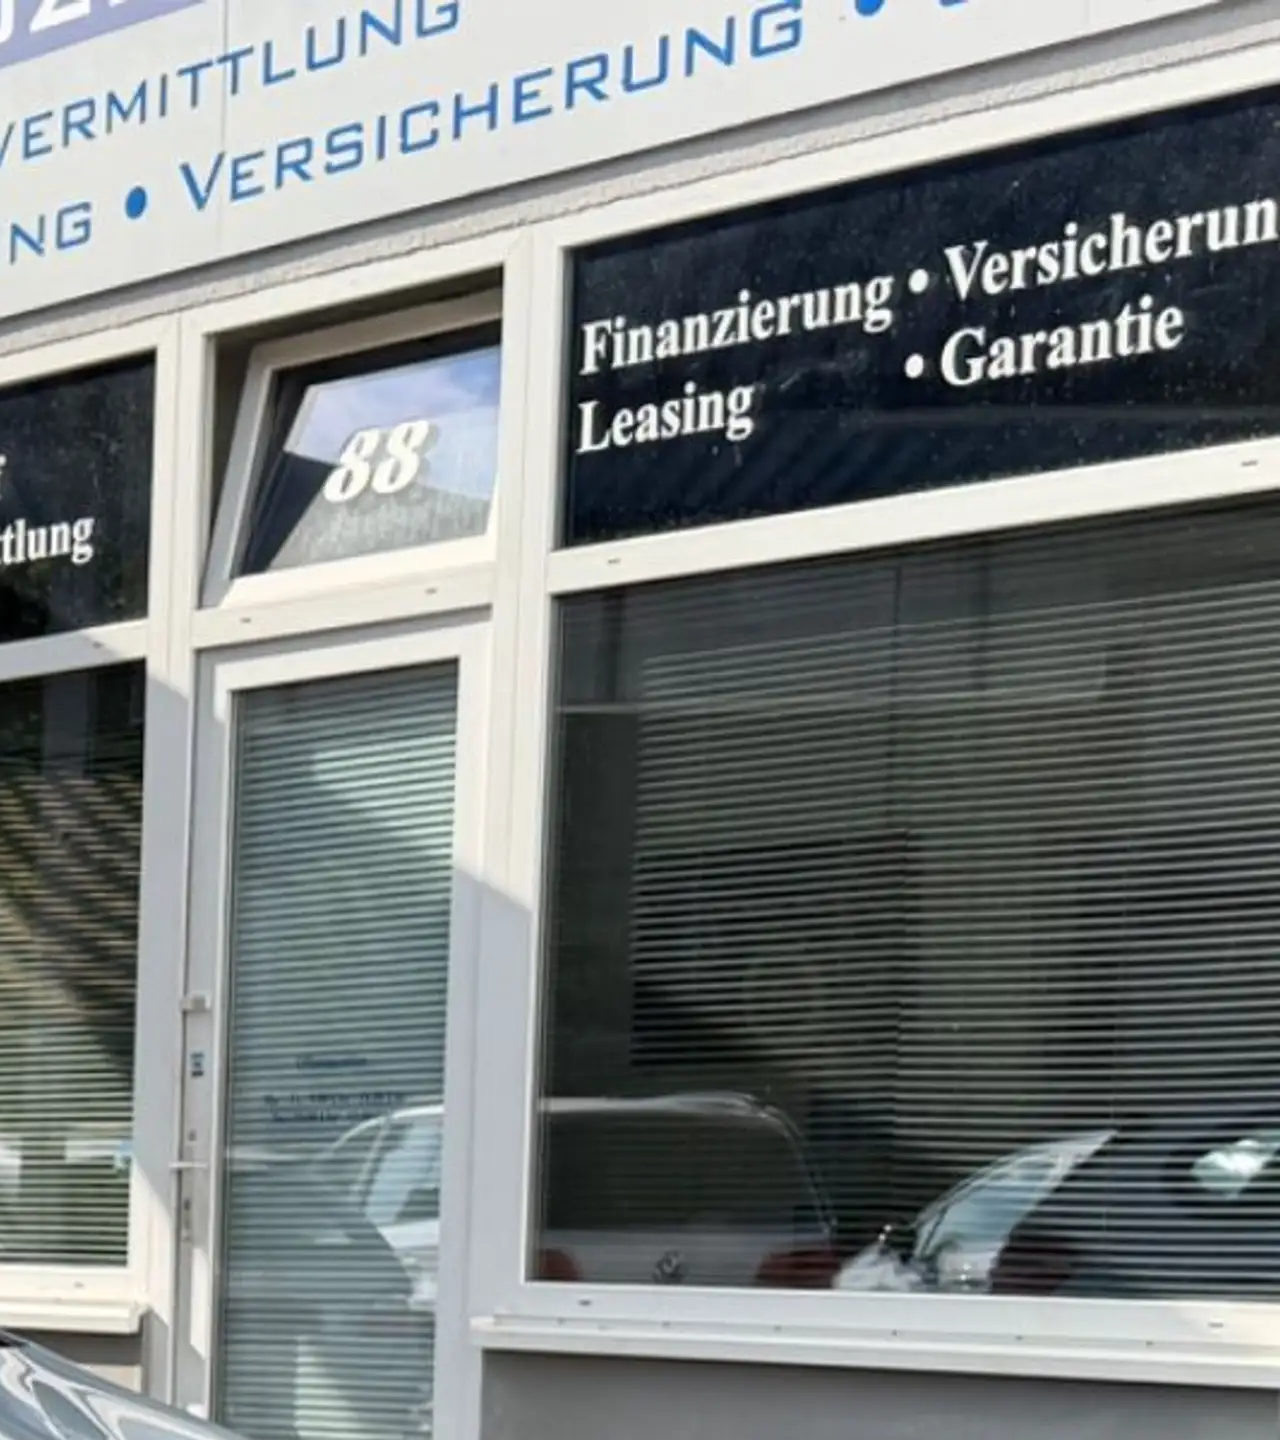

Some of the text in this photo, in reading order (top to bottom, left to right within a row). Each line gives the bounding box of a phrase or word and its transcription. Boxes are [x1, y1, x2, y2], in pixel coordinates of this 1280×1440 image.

[180, 0, 804, 212] VERSICHERUNG
[579, 273, 895, 376] Finanzierung
[940, 295, 1186, 388] Garantie
[322, 420, 430, 503] 88
[576, 381, 754, 454] Leasing
